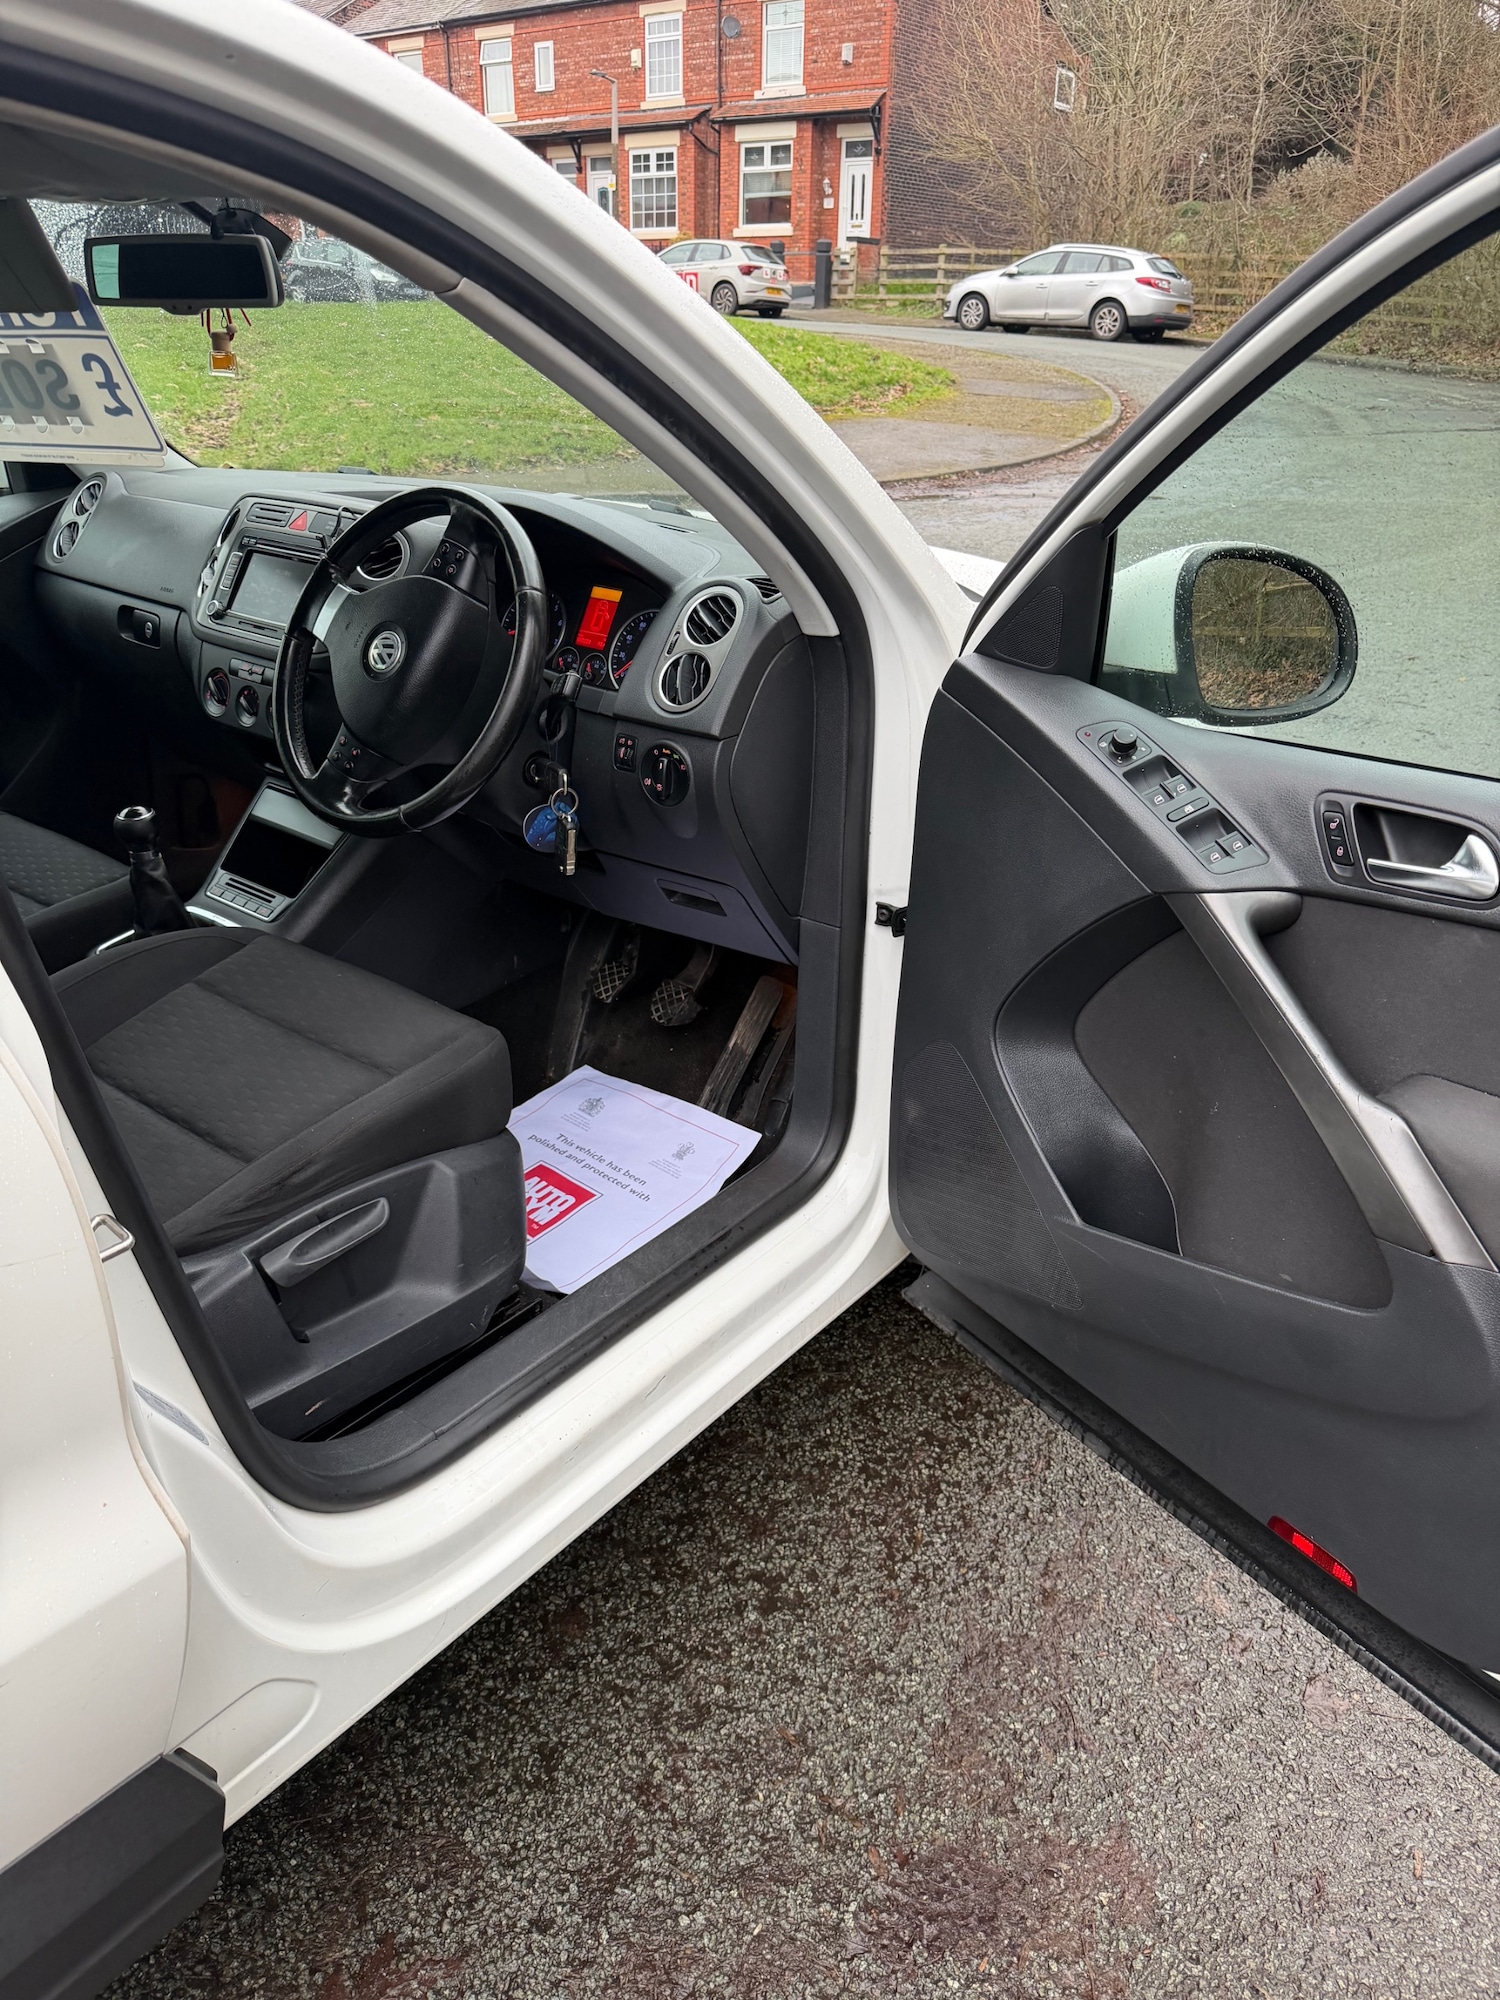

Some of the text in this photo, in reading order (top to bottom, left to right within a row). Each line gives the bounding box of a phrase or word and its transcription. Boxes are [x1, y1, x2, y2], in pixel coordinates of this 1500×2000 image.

[528, 1134, 568, 1156] polished
[565, 1151, 588, 1165] and
[581, 1162, 631, 1190] protected
[629, 1187, 651, 1202] with
[556, 1133, 576, 1147] This
[575, 1143, 606, 1164] vehicle
[605, 1160, 622, 1173] has
[622, 1169, 647, 1186] been
[525, 1176, 577, 1213] AUTO
